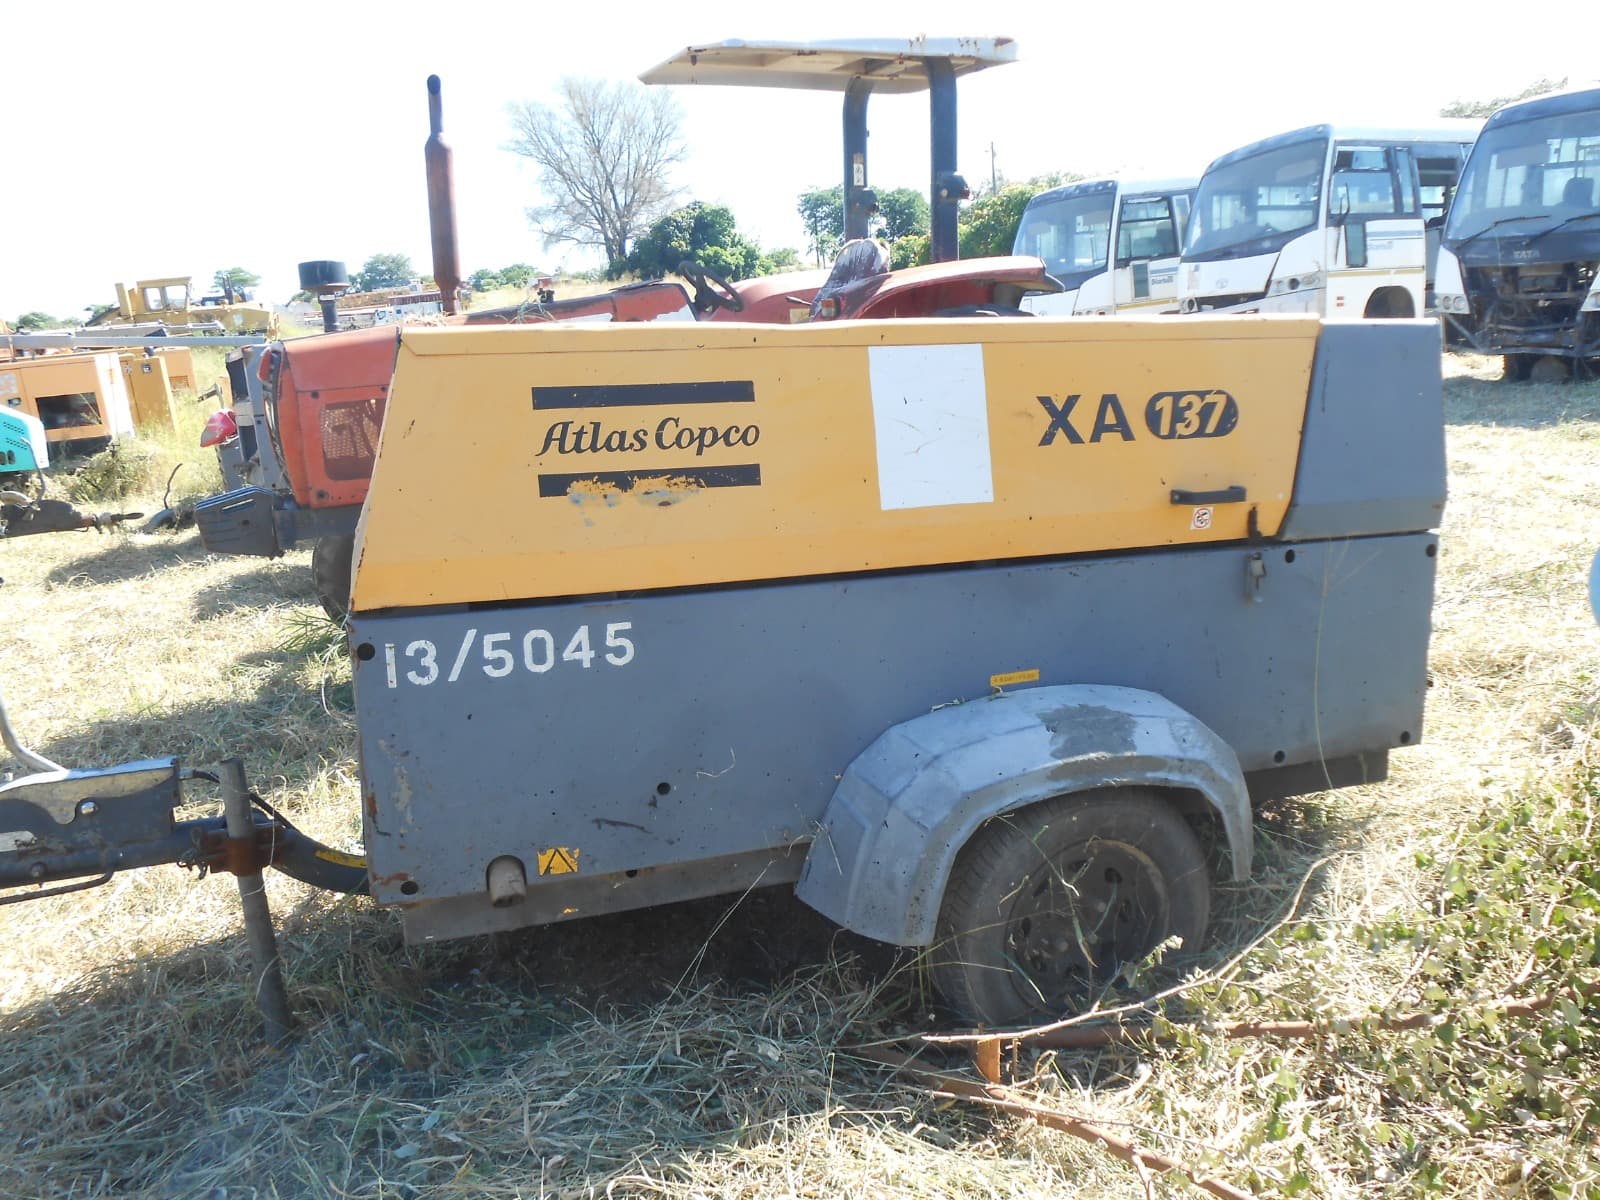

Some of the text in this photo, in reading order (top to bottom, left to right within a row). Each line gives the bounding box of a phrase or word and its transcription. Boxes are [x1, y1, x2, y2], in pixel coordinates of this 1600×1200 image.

[535, 416, 760, 457] Atlas Copco
[1037, 392, 1228, 447] XA 137
[384, 621, 635, 689] 13/5045
